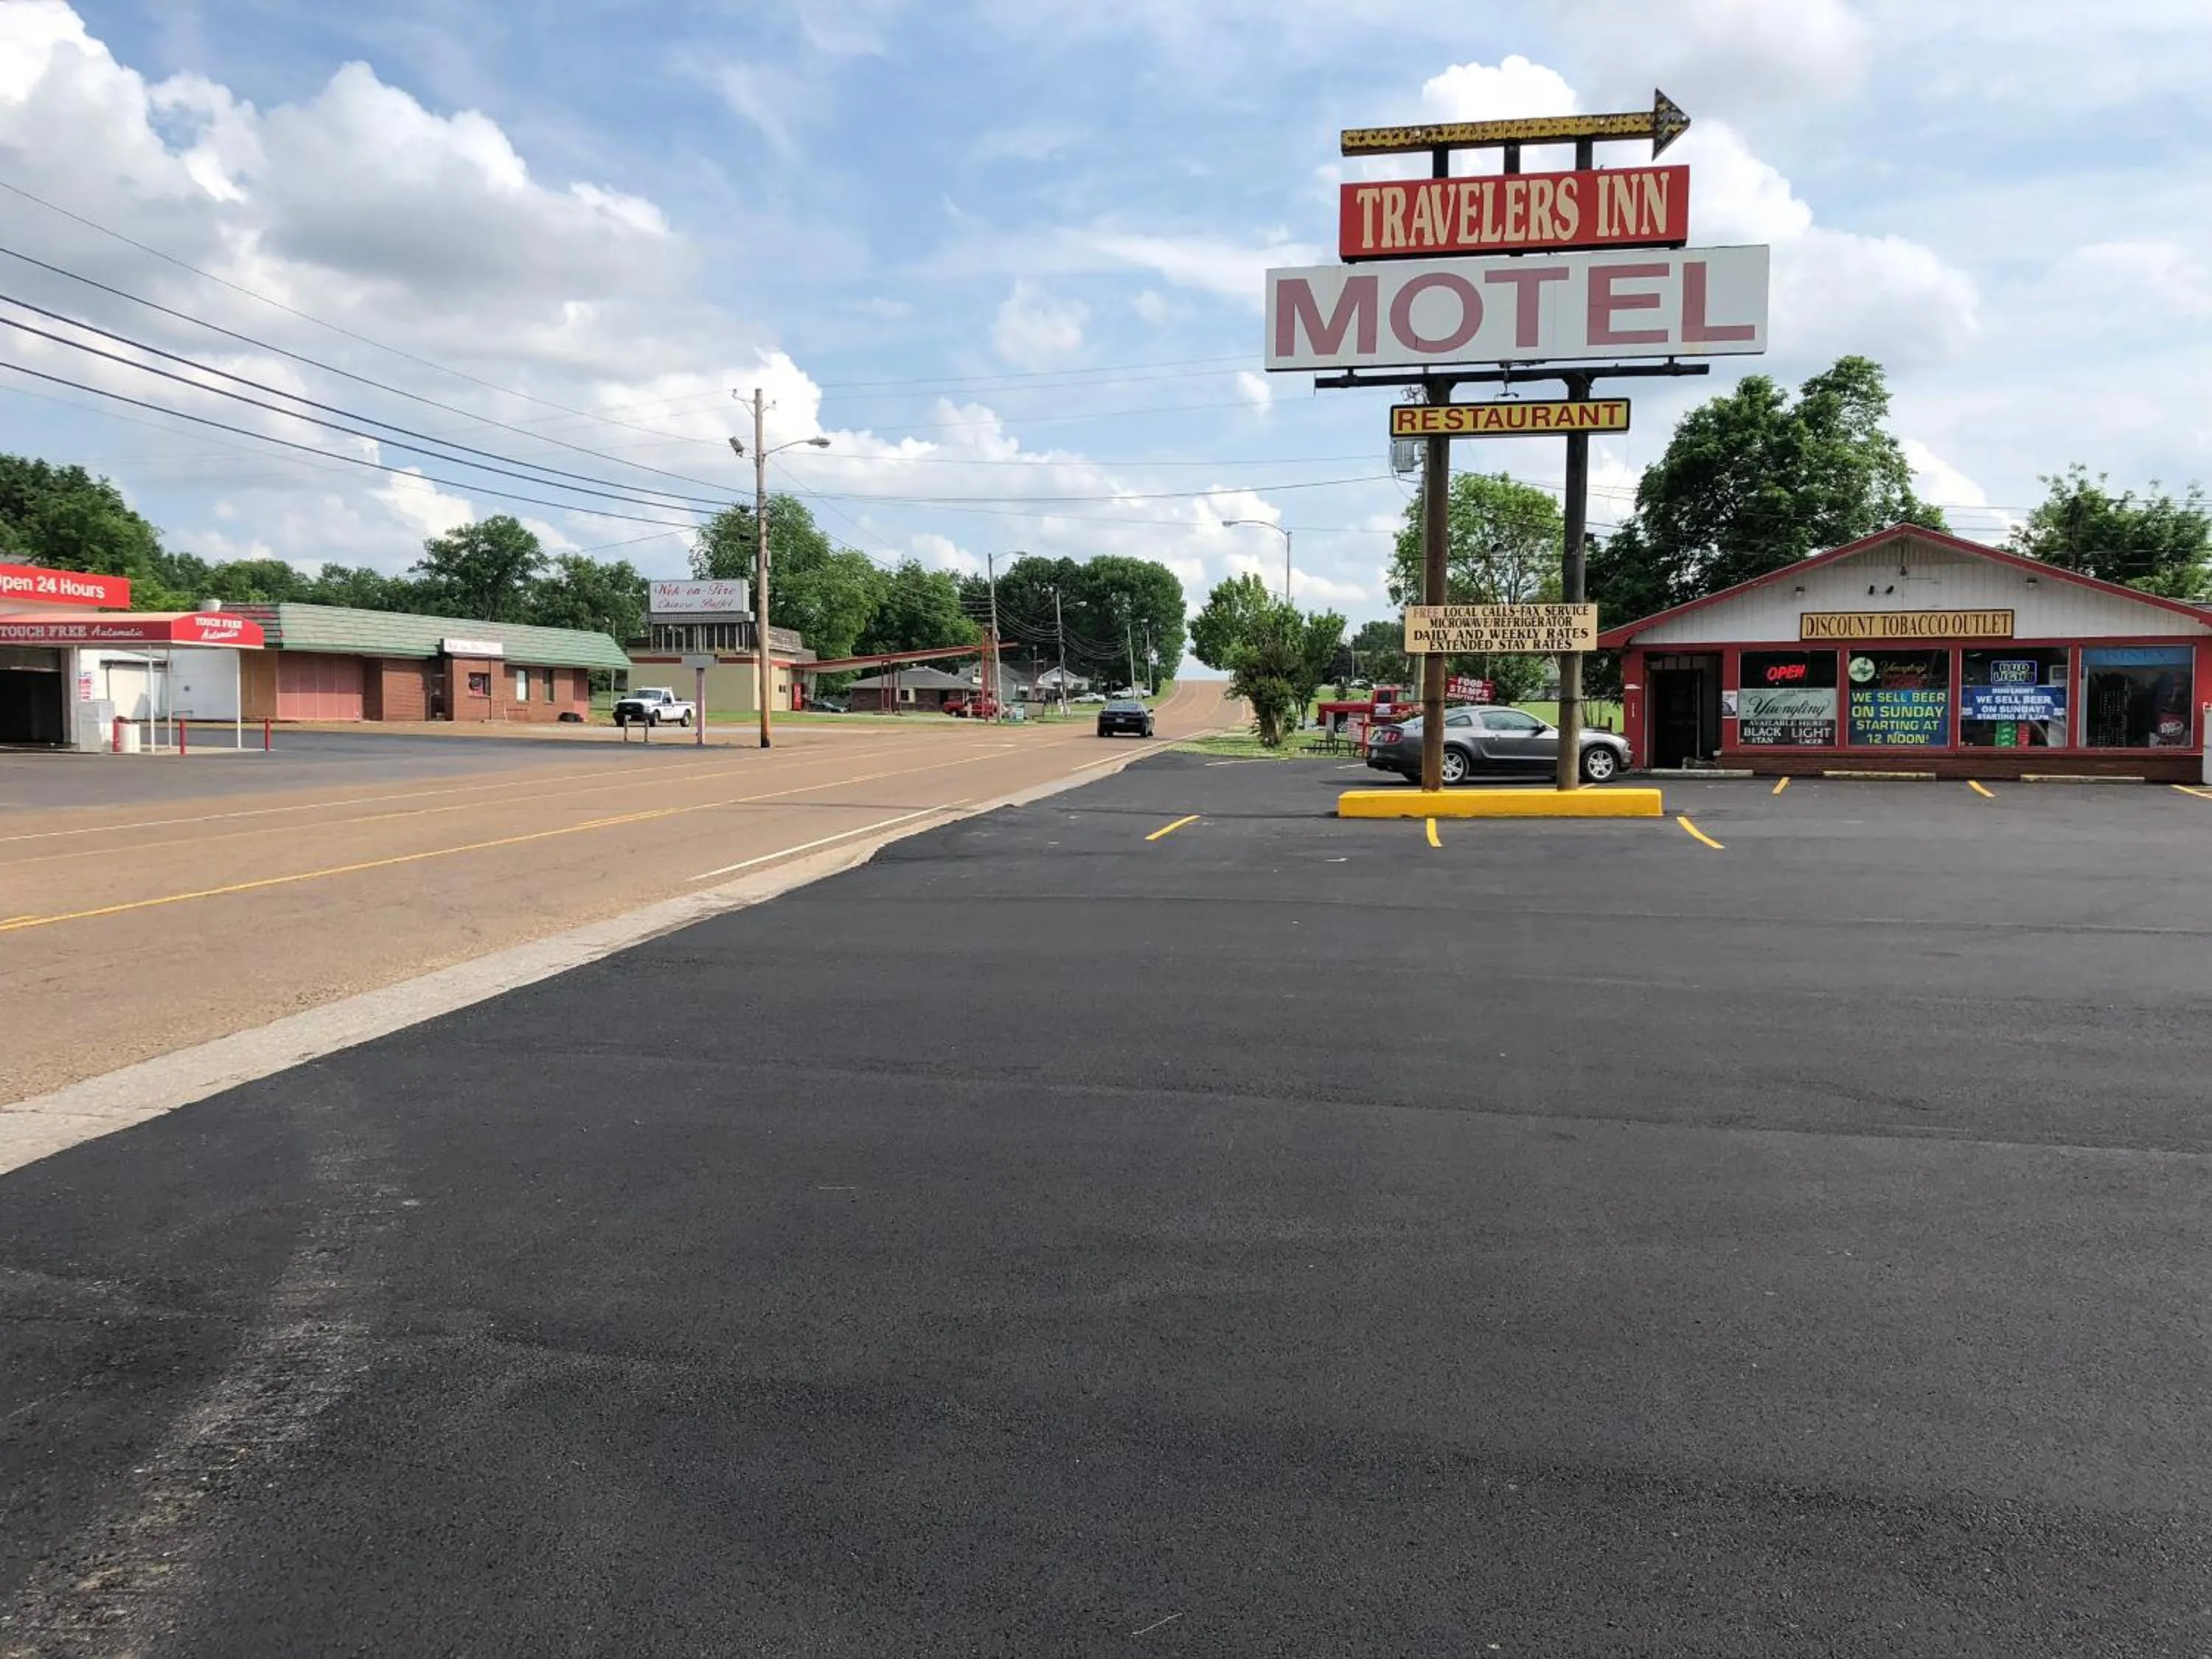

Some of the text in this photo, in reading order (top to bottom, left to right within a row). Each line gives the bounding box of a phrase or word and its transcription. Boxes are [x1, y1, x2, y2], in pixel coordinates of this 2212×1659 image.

[1357, 171, 1670, 248] TRAVELERS INN
[1274, 260, 1756, 358] MOTEL
[1397, 404, 1621, 431] RESTAURANT
[0, 573, 105, 599] pen 24 Hours
[1413, 607, 1439, 618] FREE
[1443, 607, 1478, 616] LOCAL
[1545, 605, 1589, 616] SERVICE
[1806, 613, 2009, 636] DISCOUNT TOBACCO OUTLET
[1, 625, 44, 637] TOUCH
[49, 625, 87, 637] FREE
[1413, 627, 1590, 641] DAILY AND WEEKLY RATES
[1429, 639, 1573, 651] EXTENDED STAY RATES
[1767, 664, 1805, 681] OPEN
[1457, 677, 1483, 687] FOOD
[1449, 684, 1489, 697] STAMPS
[1851, 692, 1946, 702] WE SELL BEER
[1976, 695, 2051, 704] WE SELL BEER
[1746, 696, 1830, 717] Yuengling
[1851, 706, 1944, 717] ON SUNDAY
[1999, 706, 2045, 714] SUNDAY!
[1857, 720, 1939, 730] STARTING AT
[1744, 727, 1781, 737] BLACK
[1792, 727, 1831, 738] LIGHT
[1866, 734, 1929, 744] 12 NOON!
